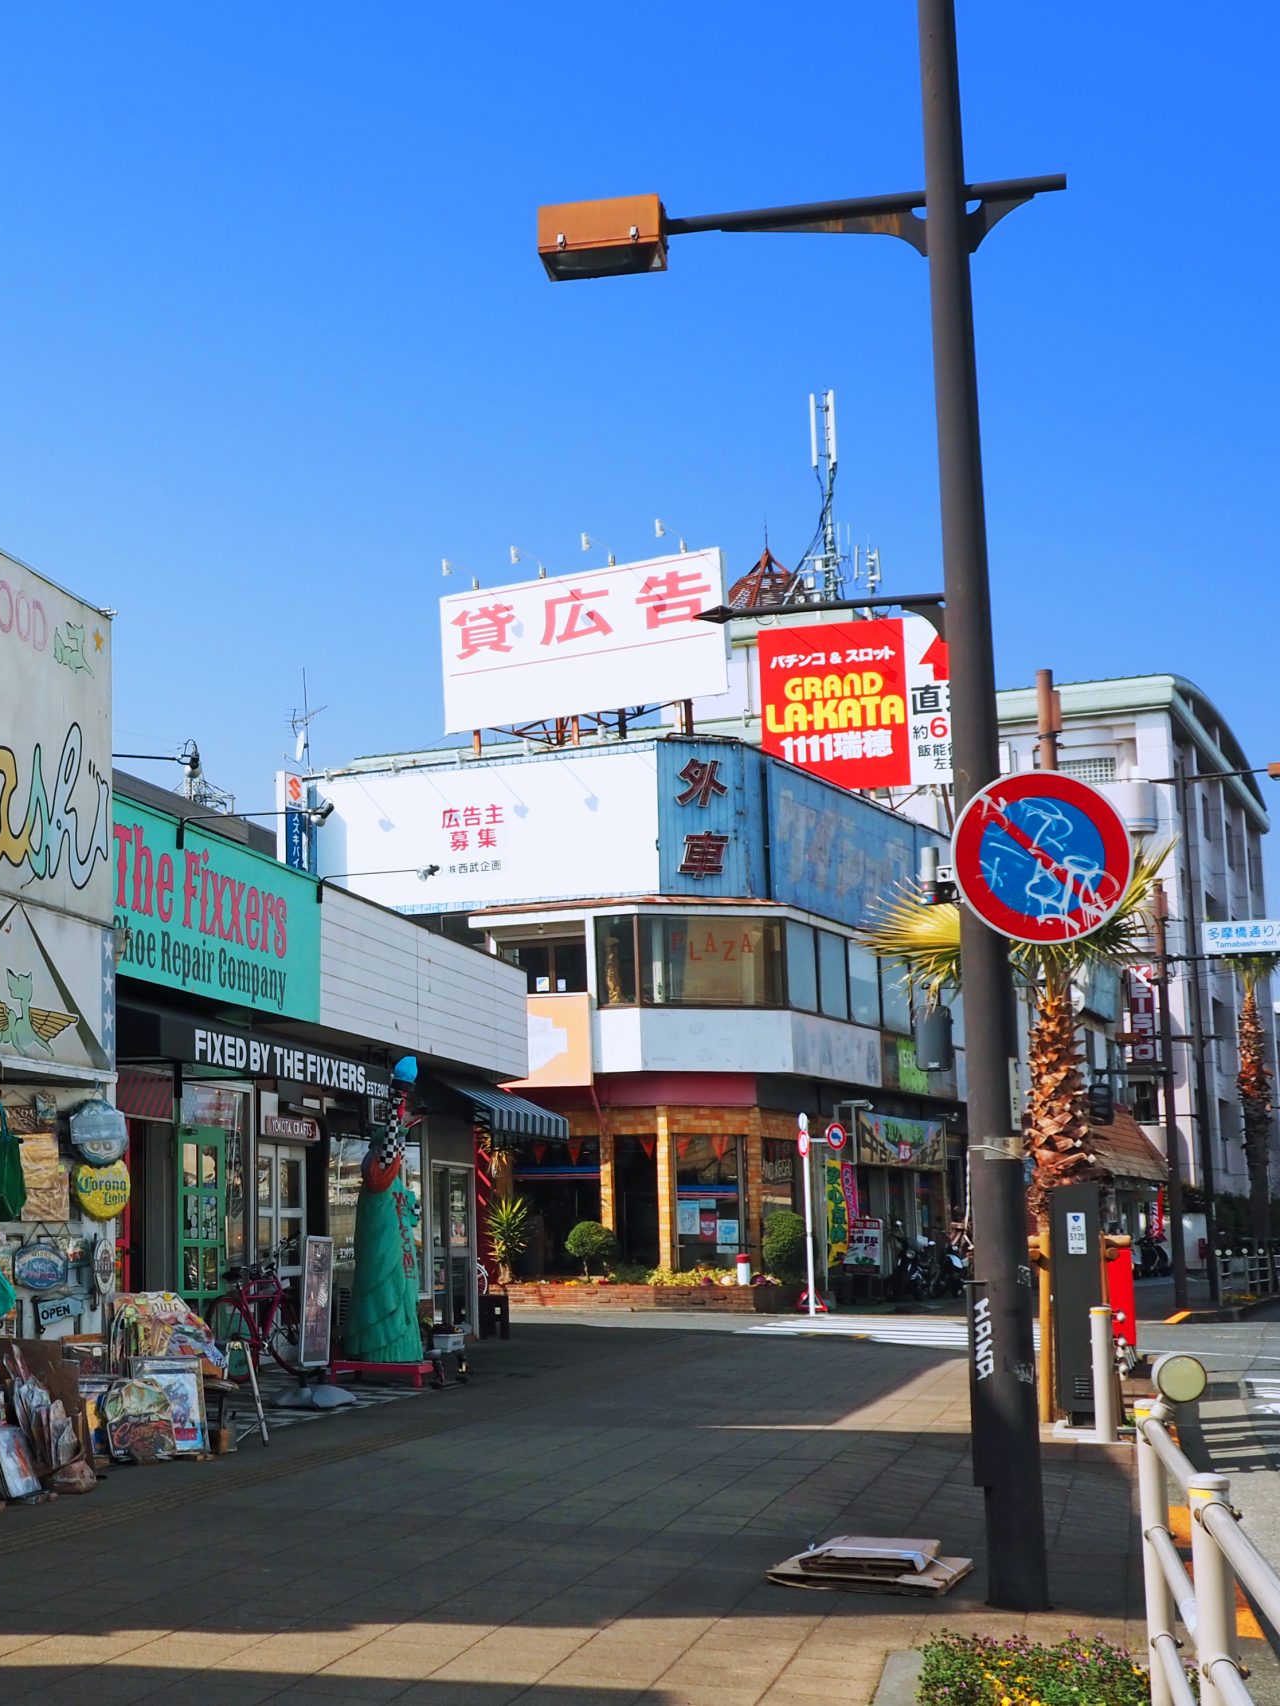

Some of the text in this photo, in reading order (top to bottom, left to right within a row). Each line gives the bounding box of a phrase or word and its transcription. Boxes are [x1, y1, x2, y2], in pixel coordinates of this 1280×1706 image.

[449, 570, 712, 661] 貸広告
[770, 645, 896, 669] パチンコ & スロット
[784, 671, 884, 702] GRAND
[442, 804, 505, 829] 広告主
[676, 757, 730, 880] 外車
[450, 828, 498, 852] 募集
[113, 821, 288, 959] The Fixxers
[161, 930, 214, 987] Repair
[219, 947, 287, 1011] Company
[195, 1029, 247, 1073] FIXED
[250, 1040, 271, 1074] BY
[273, 1046, 304, 1081] THE
[306, 1053, 366, 1095] FIXXERS
[77, 1176, 127, 1195] Corona
[102, 1191, 127, 1206] Light
[41, 1304, 71, 1320] OPEN
